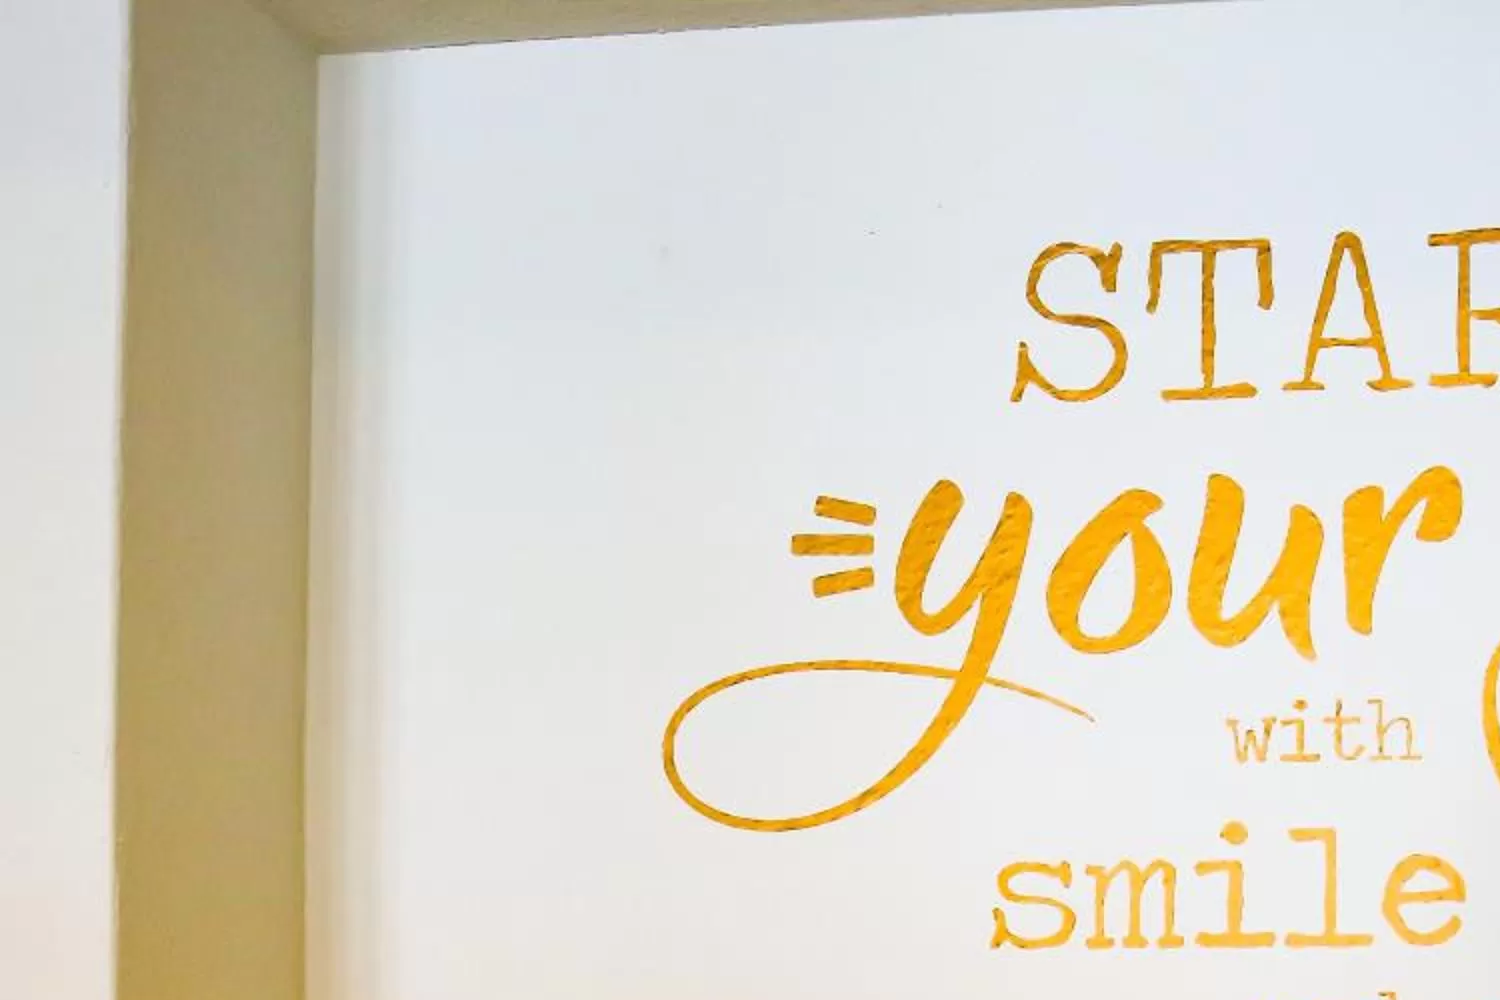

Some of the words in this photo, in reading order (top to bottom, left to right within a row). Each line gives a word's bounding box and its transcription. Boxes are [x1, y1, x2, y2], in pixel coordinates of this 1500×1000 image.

[662, 465, 1464, 832] your
[1225, 698, 1422, 764] with
[991, 822, 1467, 950] smile
